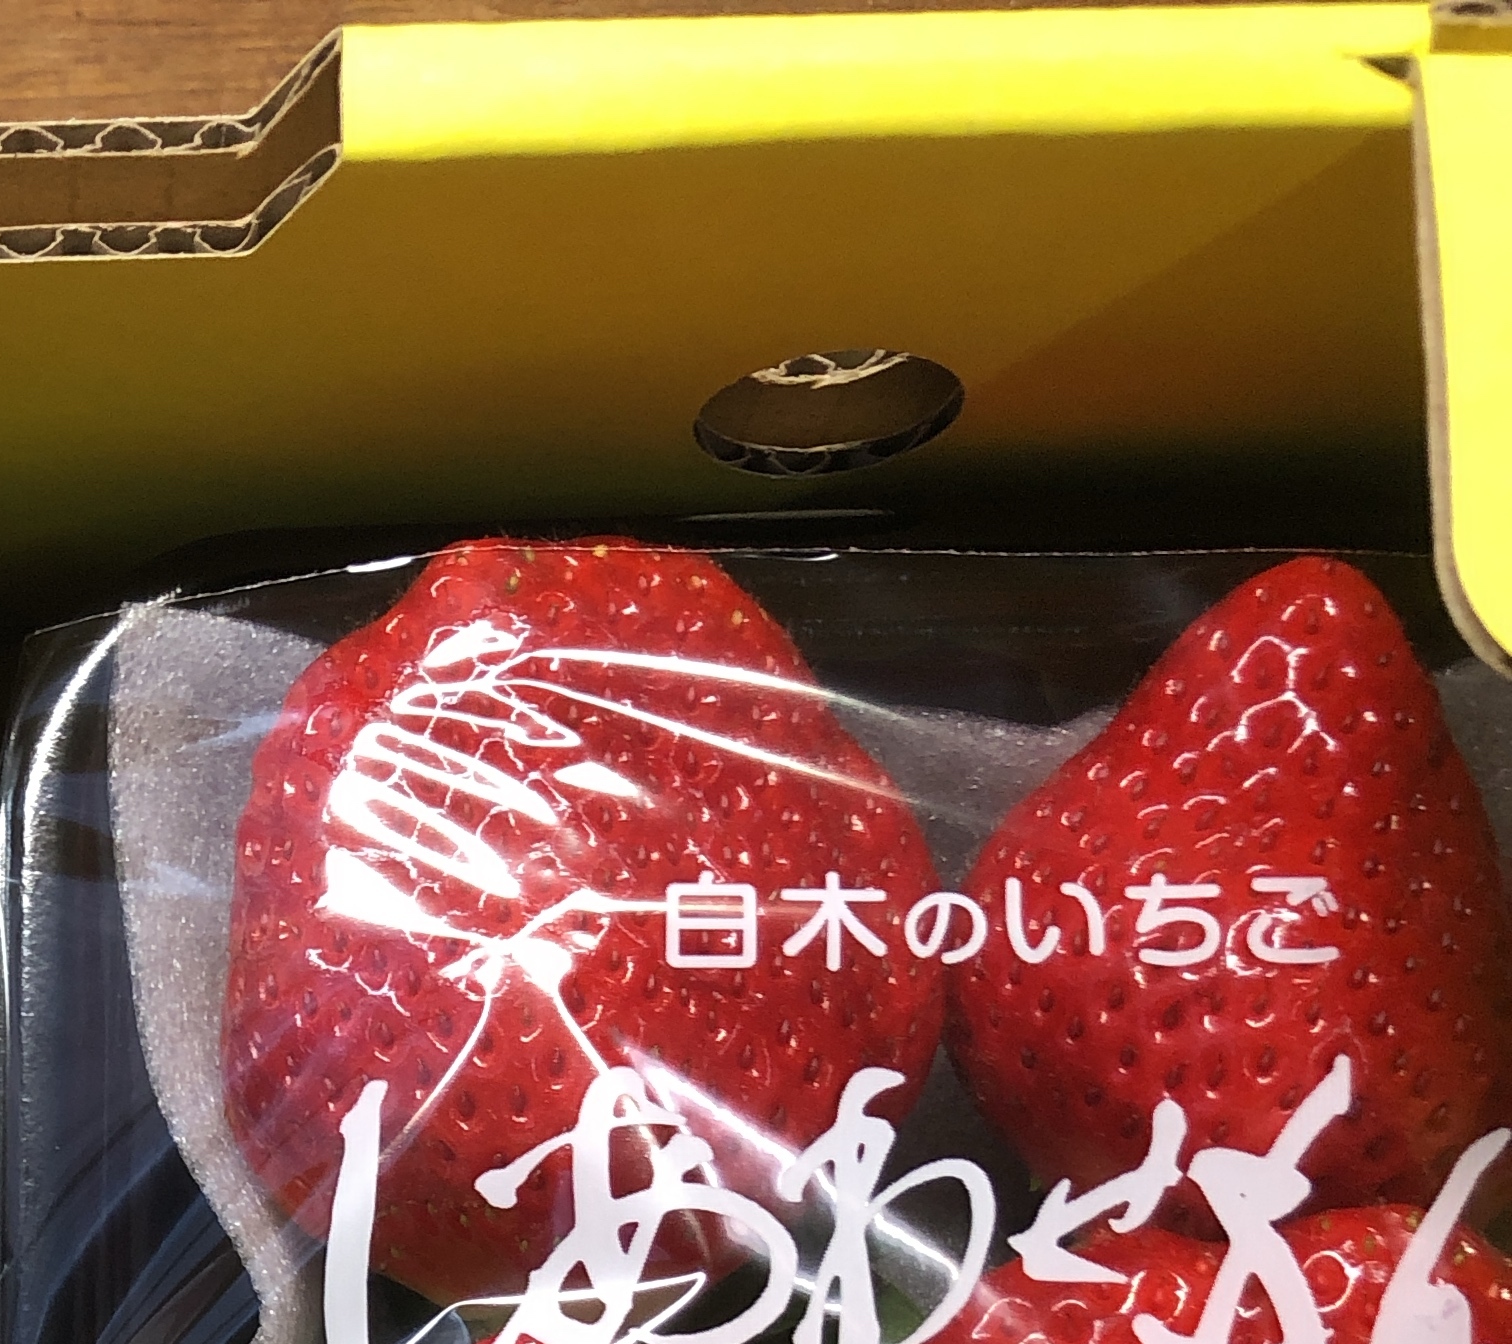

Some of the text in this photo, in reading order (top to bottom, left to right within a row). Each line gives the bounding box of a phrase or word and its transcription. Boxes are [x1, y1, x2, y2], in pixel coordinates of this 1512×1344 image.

[665, 870, 1341, 971] 白木のいちご
